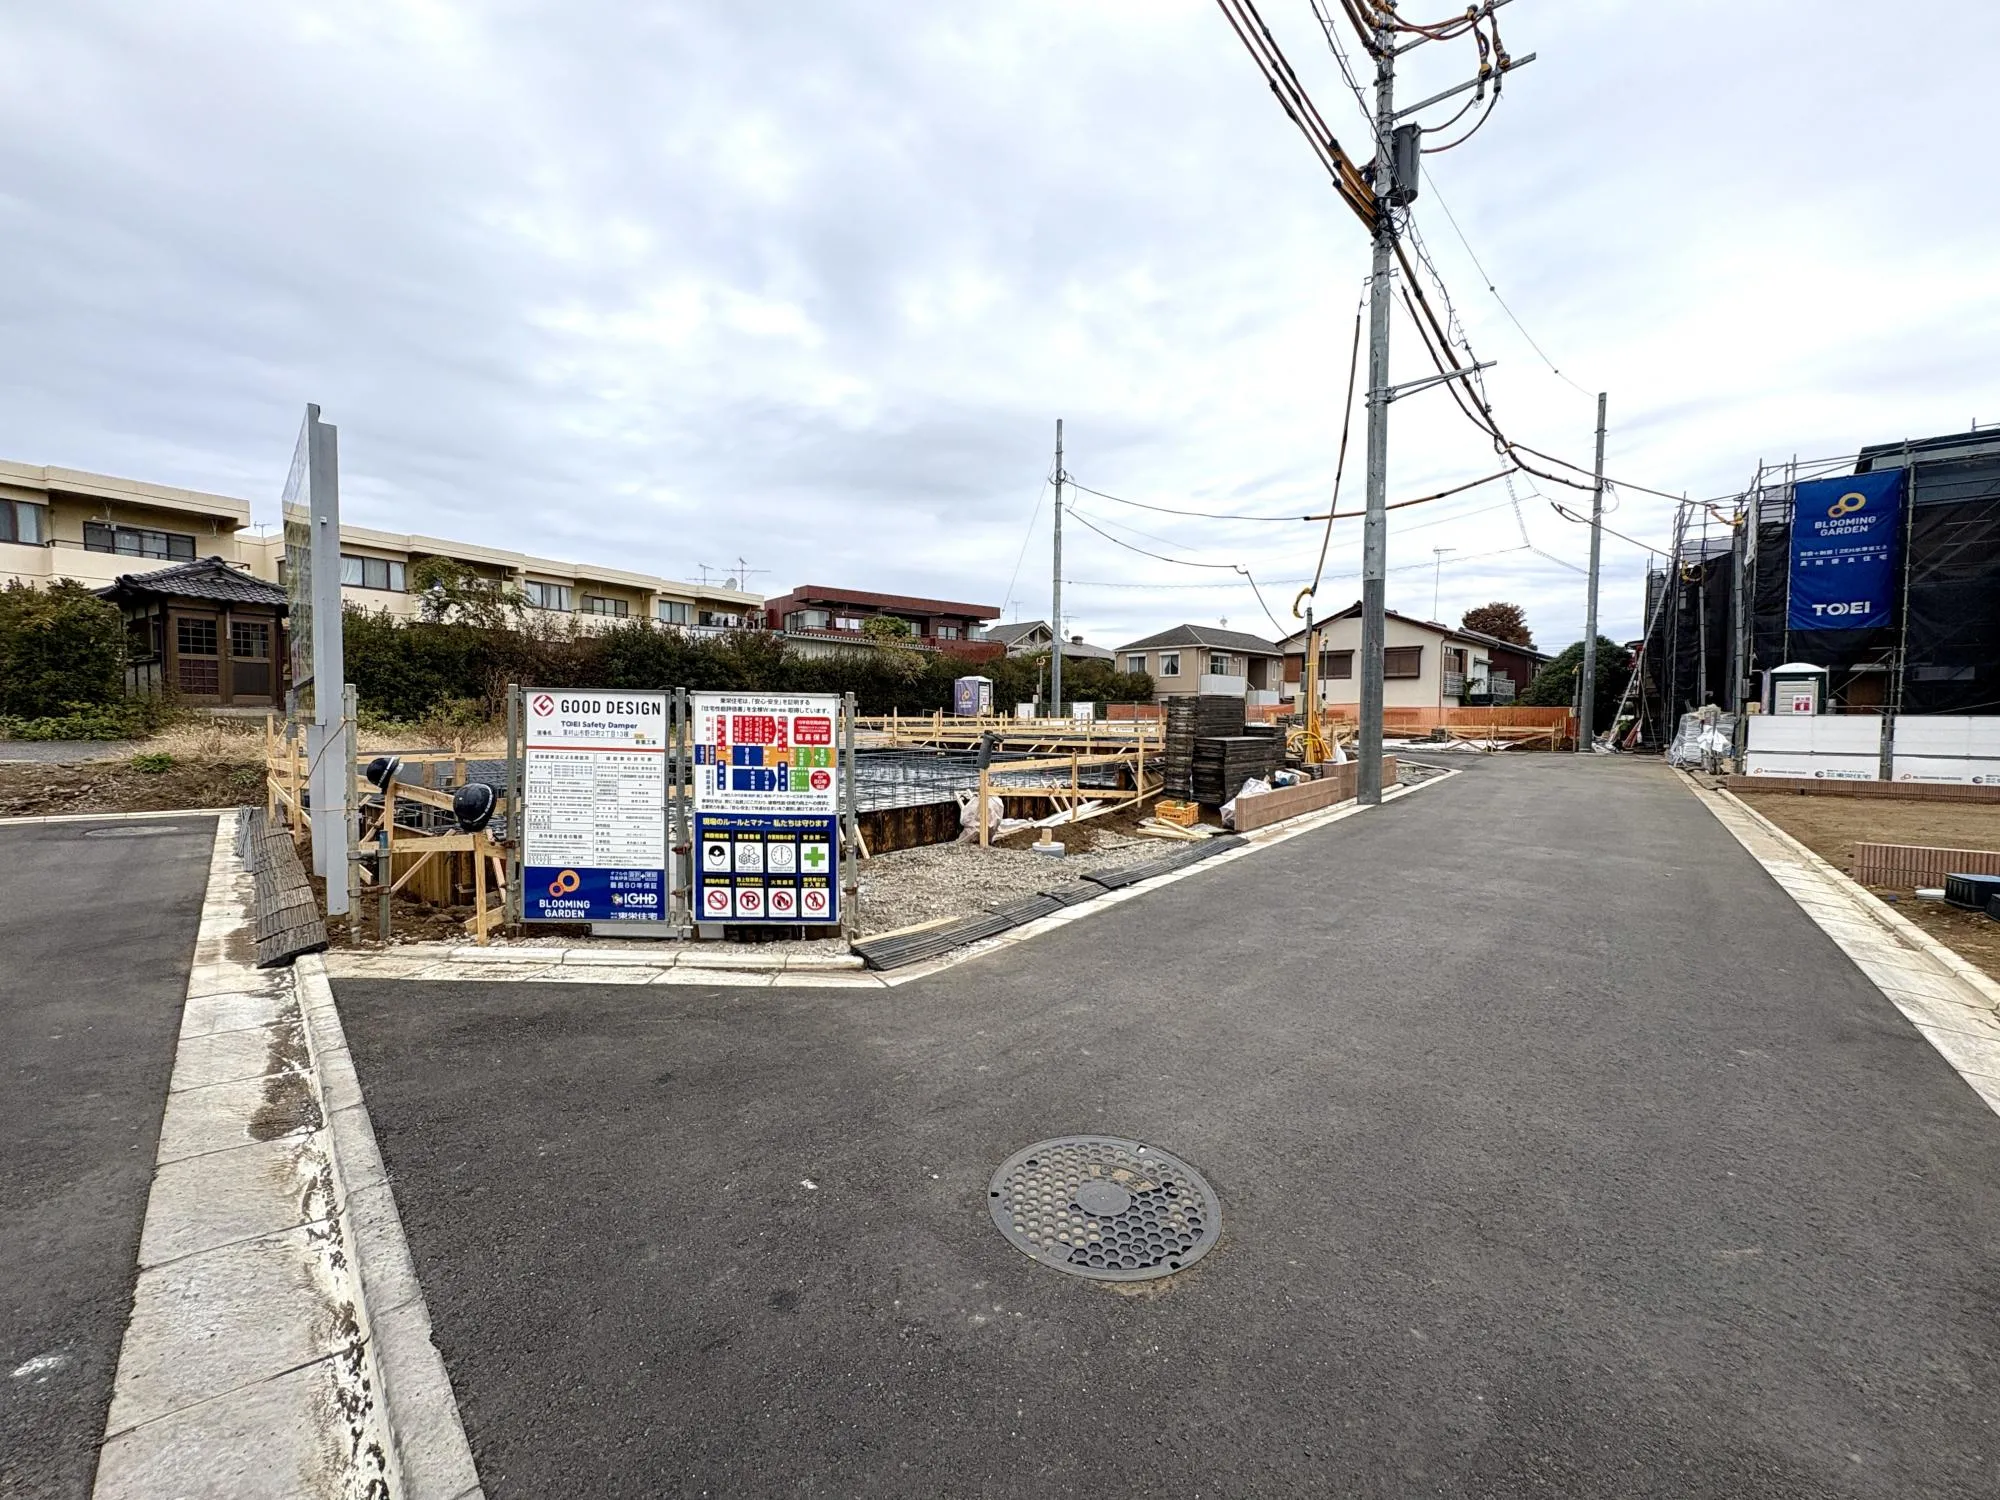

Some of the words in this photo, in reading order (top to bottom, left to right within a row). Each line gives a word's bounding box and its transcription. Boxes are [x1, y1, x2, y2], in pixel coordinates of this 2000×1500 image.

[1814, 516, 1877, 529] BLOOMING
[1820, 525, 1869, 537] GARDEN
[561, 699, 601, 714] GOOD
[606, 700, 661, 715] DESIGN
[582, 720, 606, 730] Safety
[608, 721, 638, 730] Damper
[702, 817, 771, 826] 現場のルールとマナー
[773, 819, 829, 827] 私たちは守ります
[539, 899, 591, 909] BLOOMING
[624, 893, 658, 905] IGHD
[544, 909, 585, 918] GARDEN
